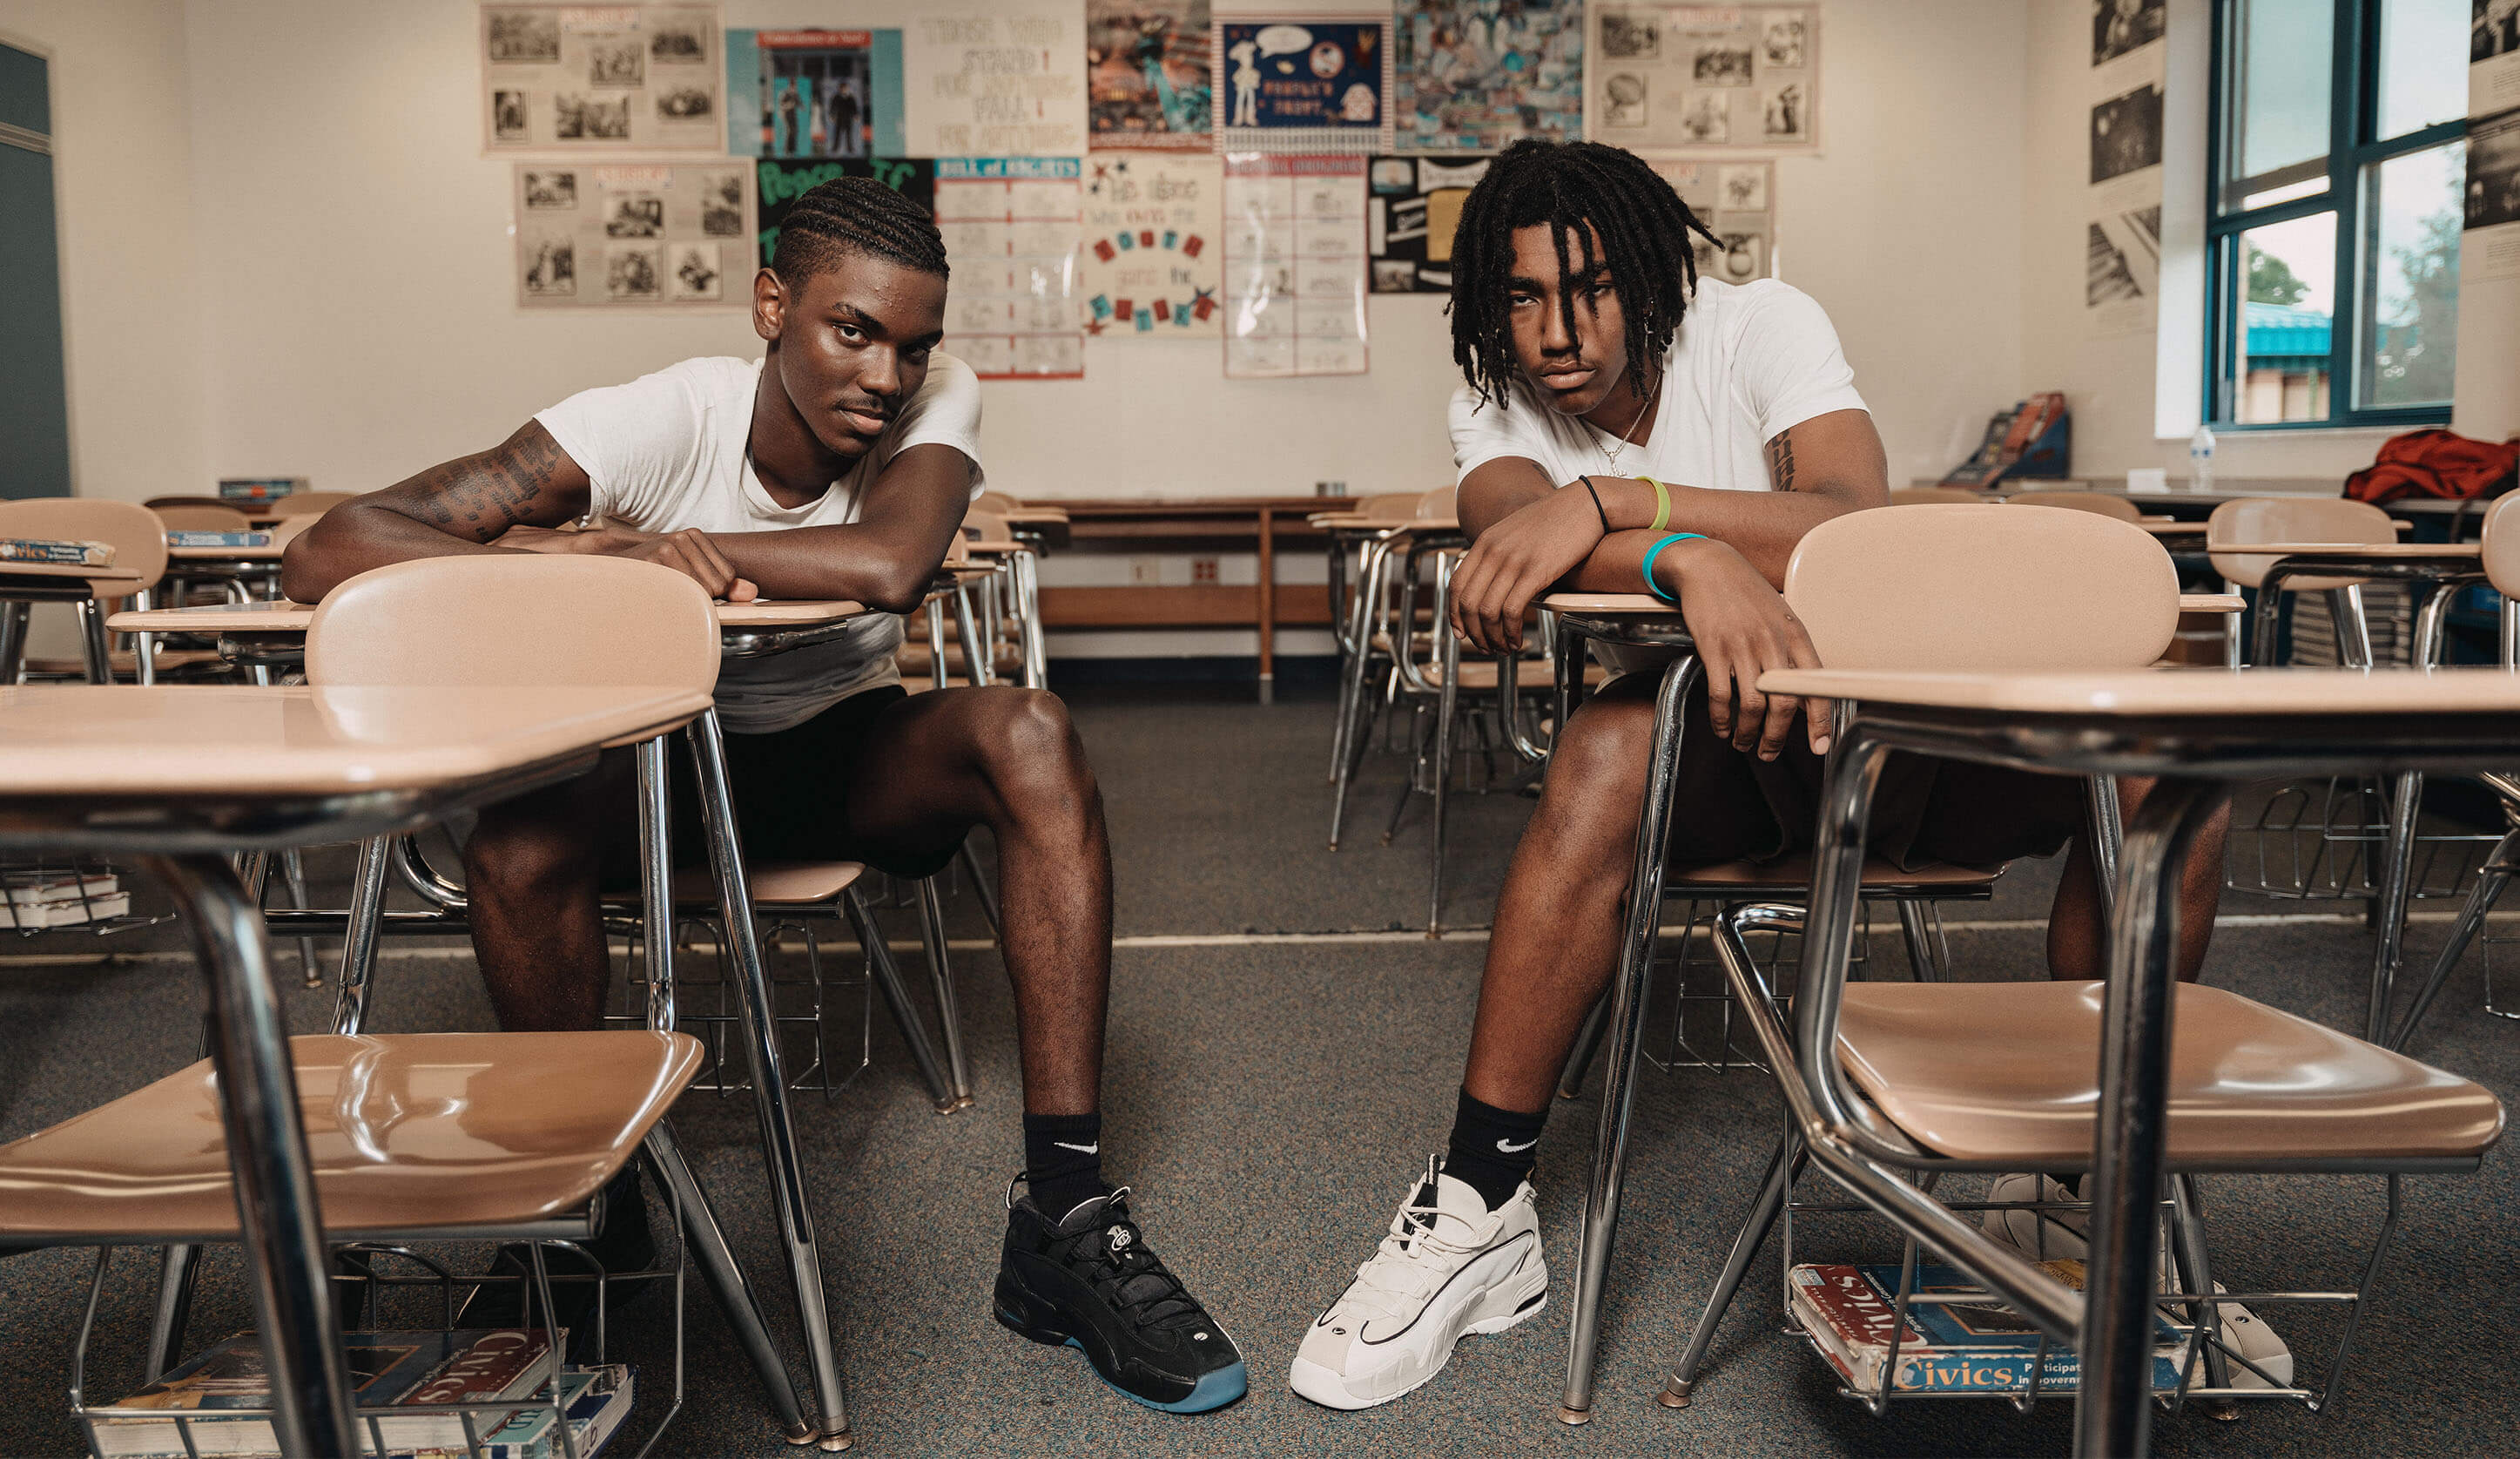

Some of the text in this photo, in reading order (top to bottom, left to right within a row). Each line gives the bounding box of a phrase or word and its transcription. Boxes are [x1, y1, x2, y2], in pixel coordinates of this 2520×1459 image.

[939, 159, 979, 177] BILL
[1007, 159, 1077, 177] RIGHTS
[1831, 1275, 1929, 1346] Civics
[418, 1332, 528, 1402] Civics
[1891, 1361, 2014, 1390] Civics
